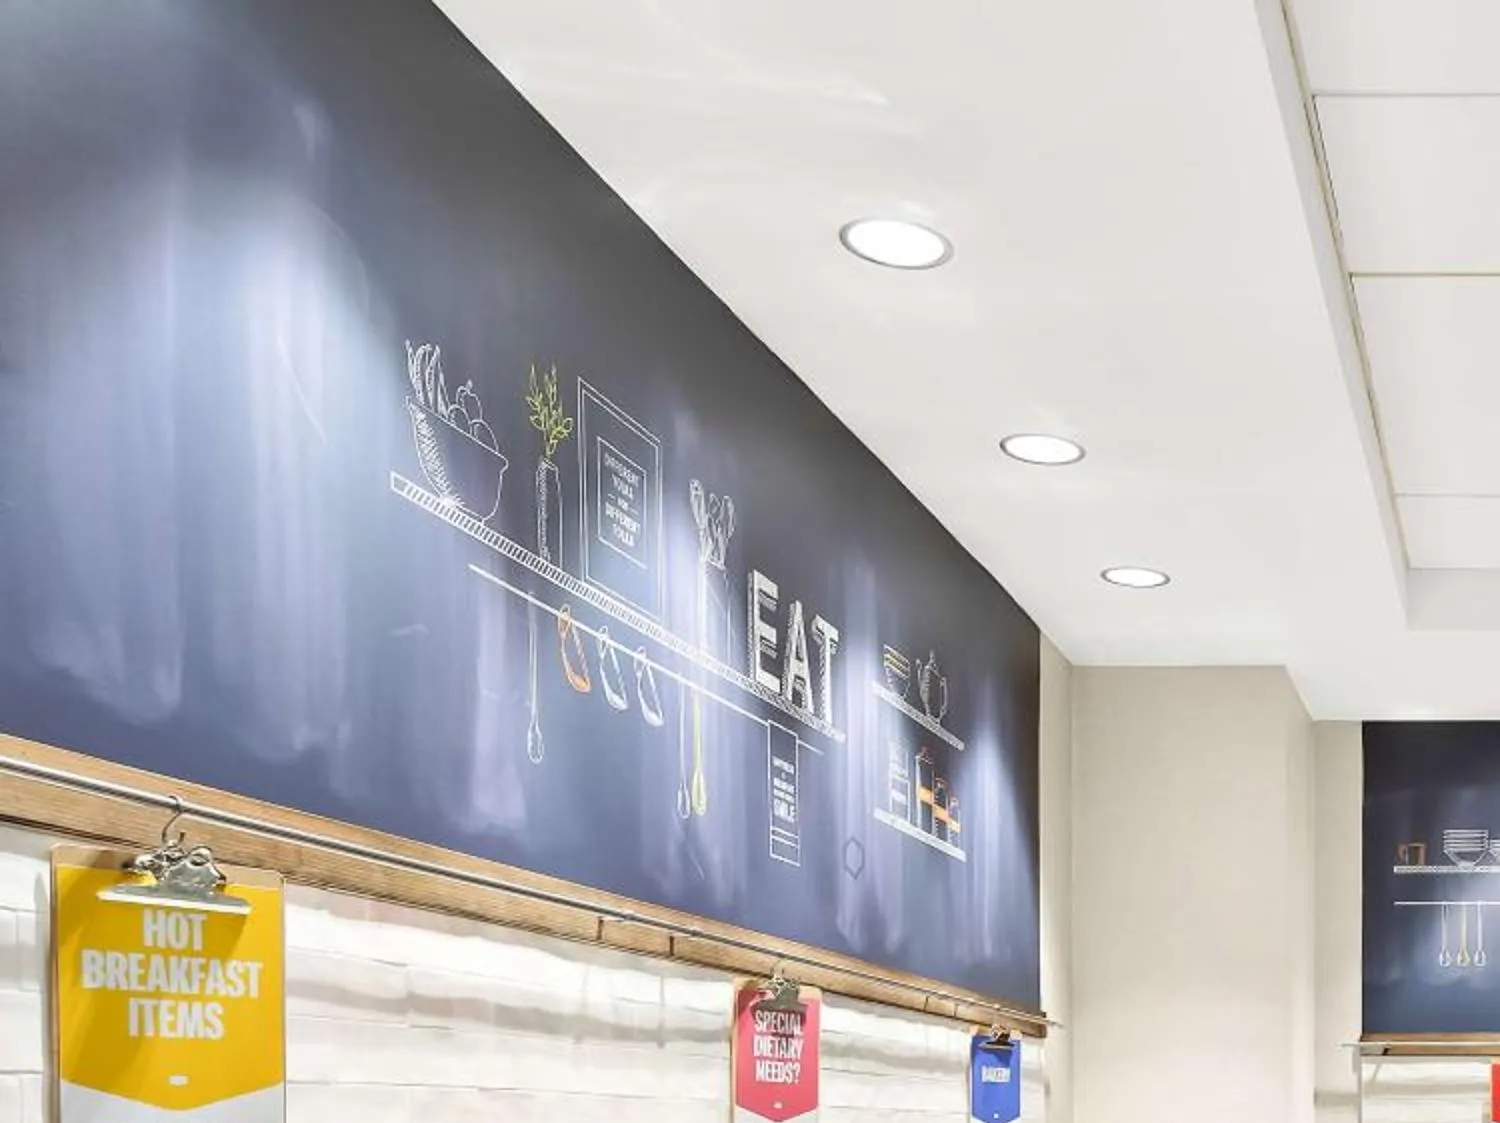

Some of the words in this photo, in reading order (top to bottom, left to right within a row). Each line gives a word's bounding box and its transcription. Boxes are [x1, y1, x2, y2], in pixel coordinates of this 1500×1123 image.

[748, 569, 839, 727] EAT
[142, 909, 207, 951] HOT
[80, 949, 264, 999] BREAKFAST
[128, 997, 225, 1039] ITEMS
[754, 1010, 804, 1037] SPECIAL
[753, 1034, 804, 1060] DIETARY
[755, 1059, 801, 1084] NEEDS?
